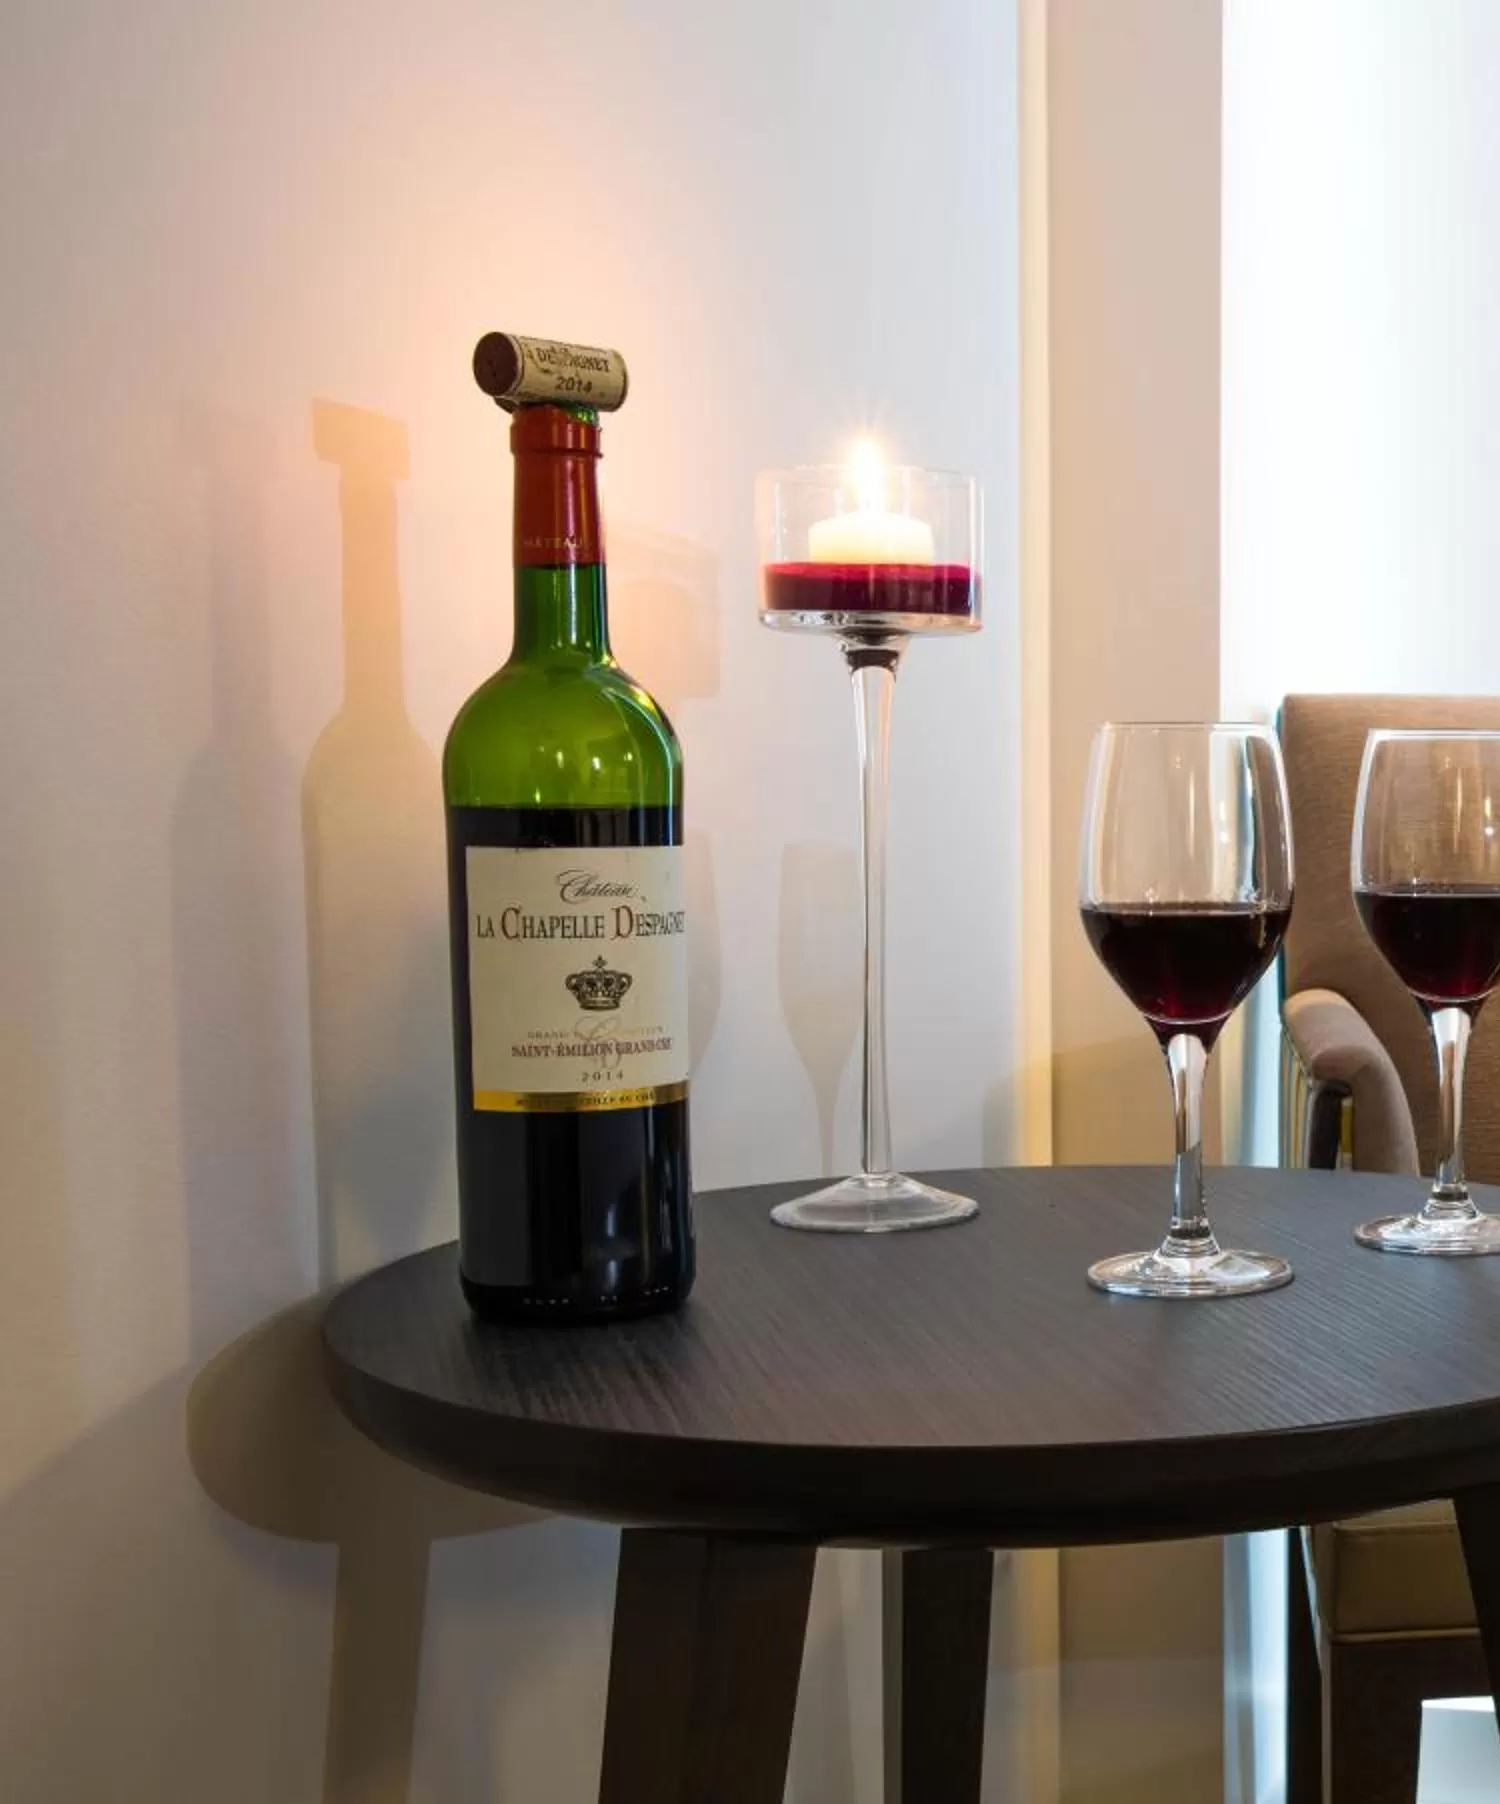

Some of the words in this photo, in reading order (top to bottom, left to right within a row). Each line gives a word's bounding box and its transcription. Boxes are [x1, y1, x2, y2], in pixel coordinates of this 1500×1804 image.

[554, 375, 593, 393] 2014
[476, 914, 495, 939] LA
[501, 905, 605, 941] CHAPELLE
[581, 1069, 624, 1083] 2014
